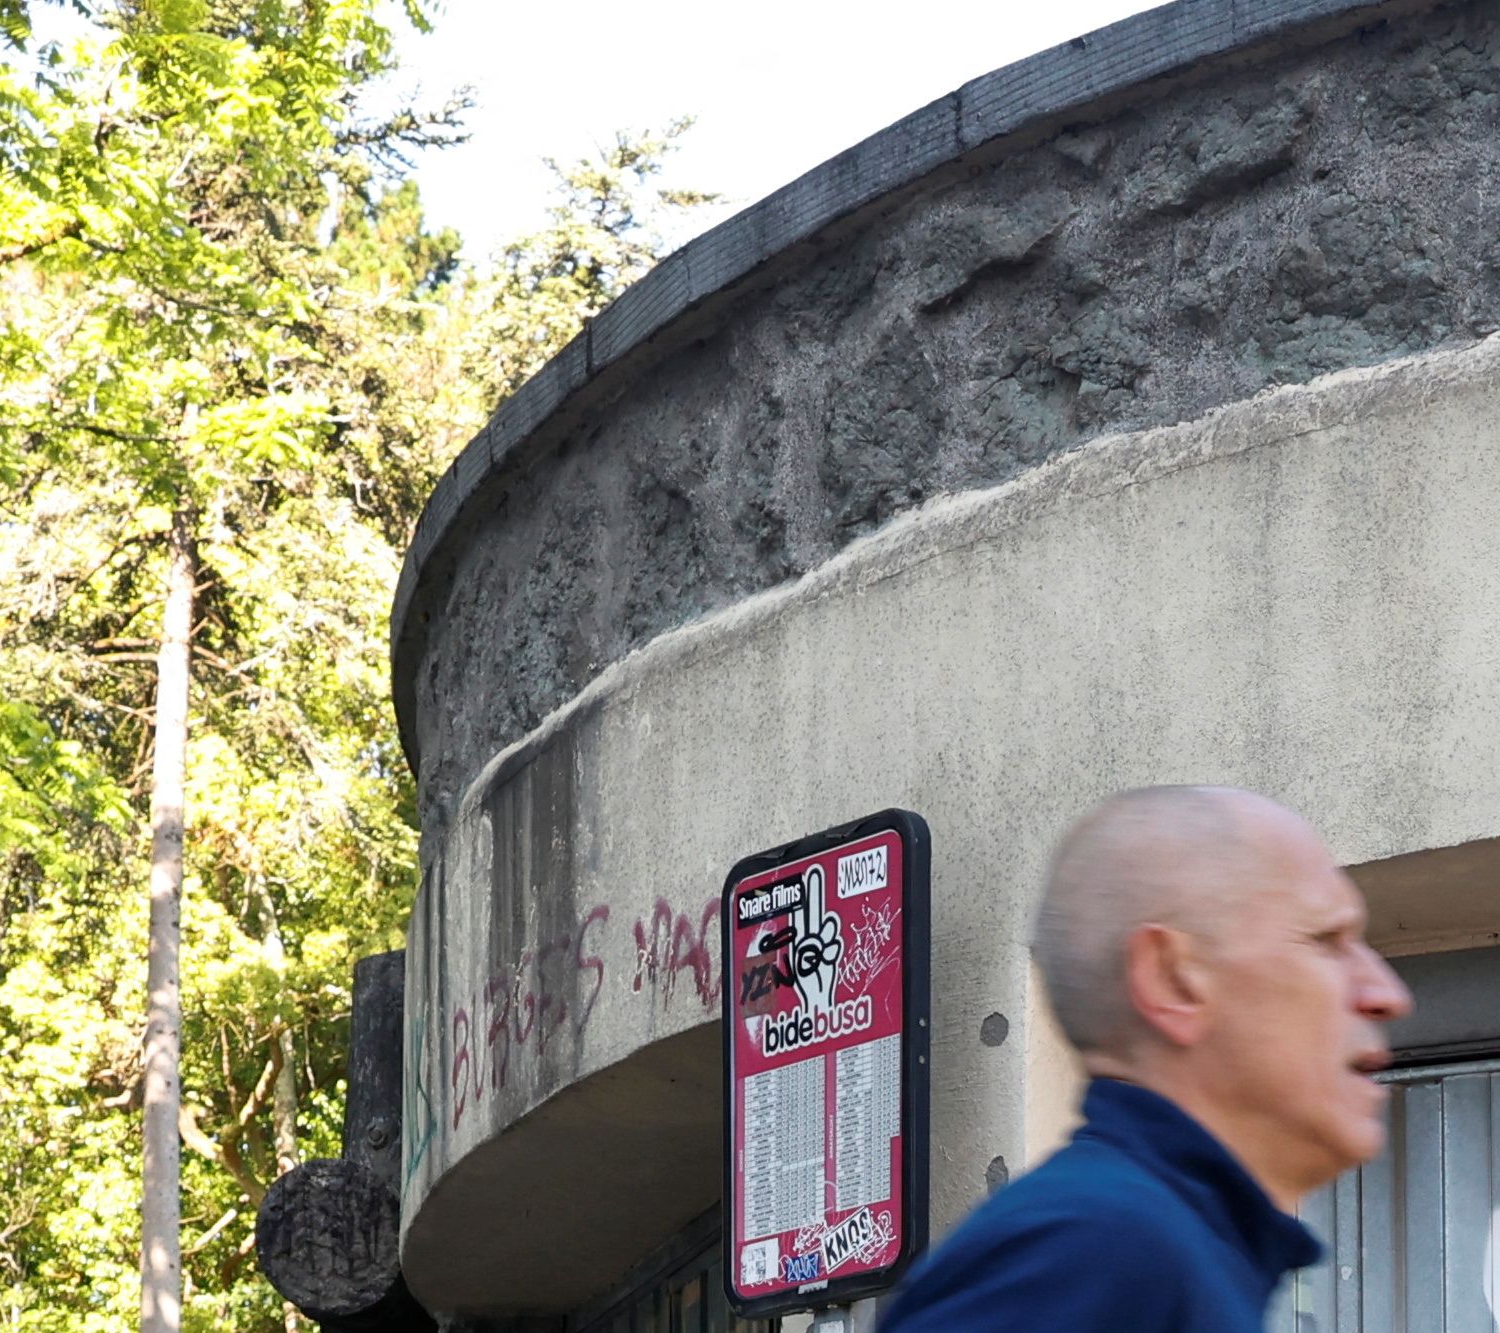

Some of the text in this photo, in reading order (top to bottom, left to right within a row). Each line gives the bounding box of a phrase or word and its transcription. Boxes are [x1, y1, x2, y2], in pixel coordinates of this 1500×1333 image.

[739, 882, 801, 920] Snare films
[764, 996, 870, 1053] bidebusa
